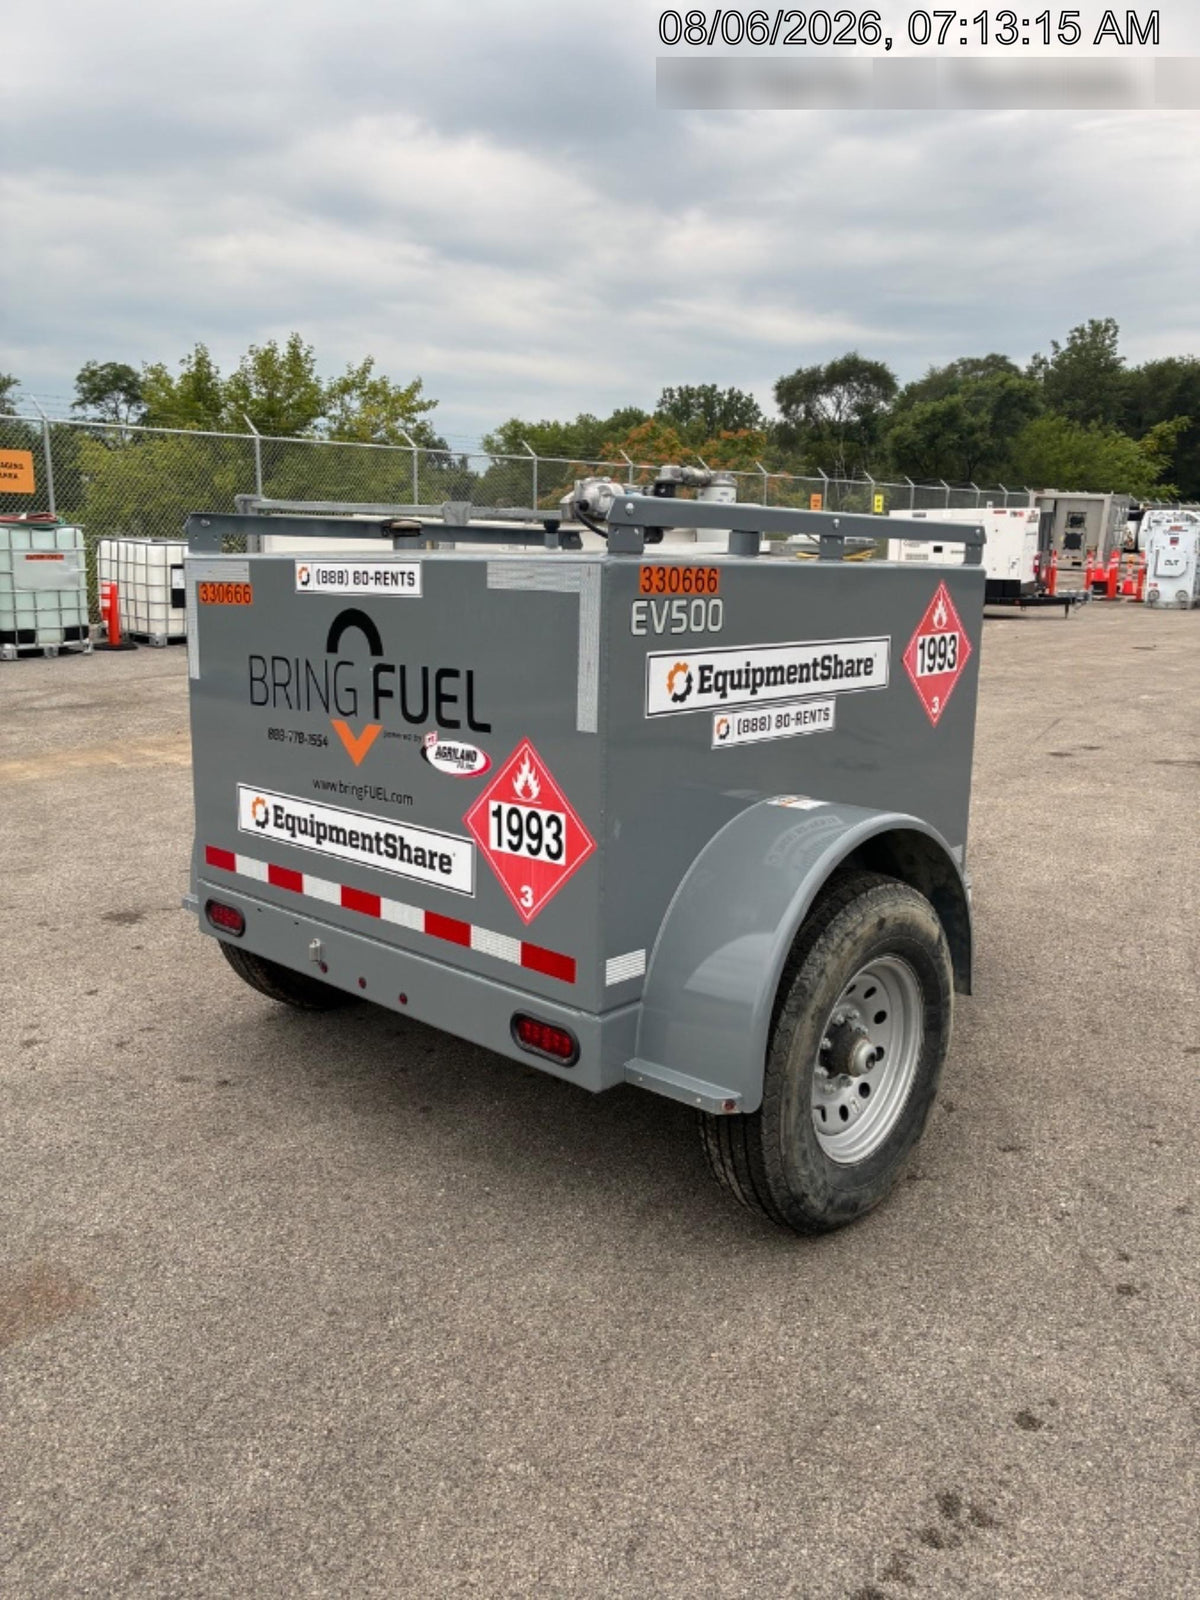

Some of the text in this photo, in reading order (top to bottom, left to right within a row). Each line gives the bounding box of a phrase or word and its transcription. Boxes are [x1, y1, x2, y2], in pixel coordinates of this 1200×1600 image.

[316, 569, 416, 588] (888) 80-RENTS
[641, 566, 720, 593] 330666
[201, 584, 252, 605] 330666
[631, 599, 724, 636] EV500
[917, 634, 958, 674] 1993
[697, 654, 874, 695] EquipmentShare
[249, 655, 492, 734] BRING FUEL
[931, 696, 940, 713] 3
[736, 706, 831, 736] (888) 80-RENTS
[312, 778, 413, 806] www.bringFUEL.com
[272, 805, 453, 876] EquipmentShare
[490, 804, 564, 862] 1993
[520, 884, 533, 908] 3
